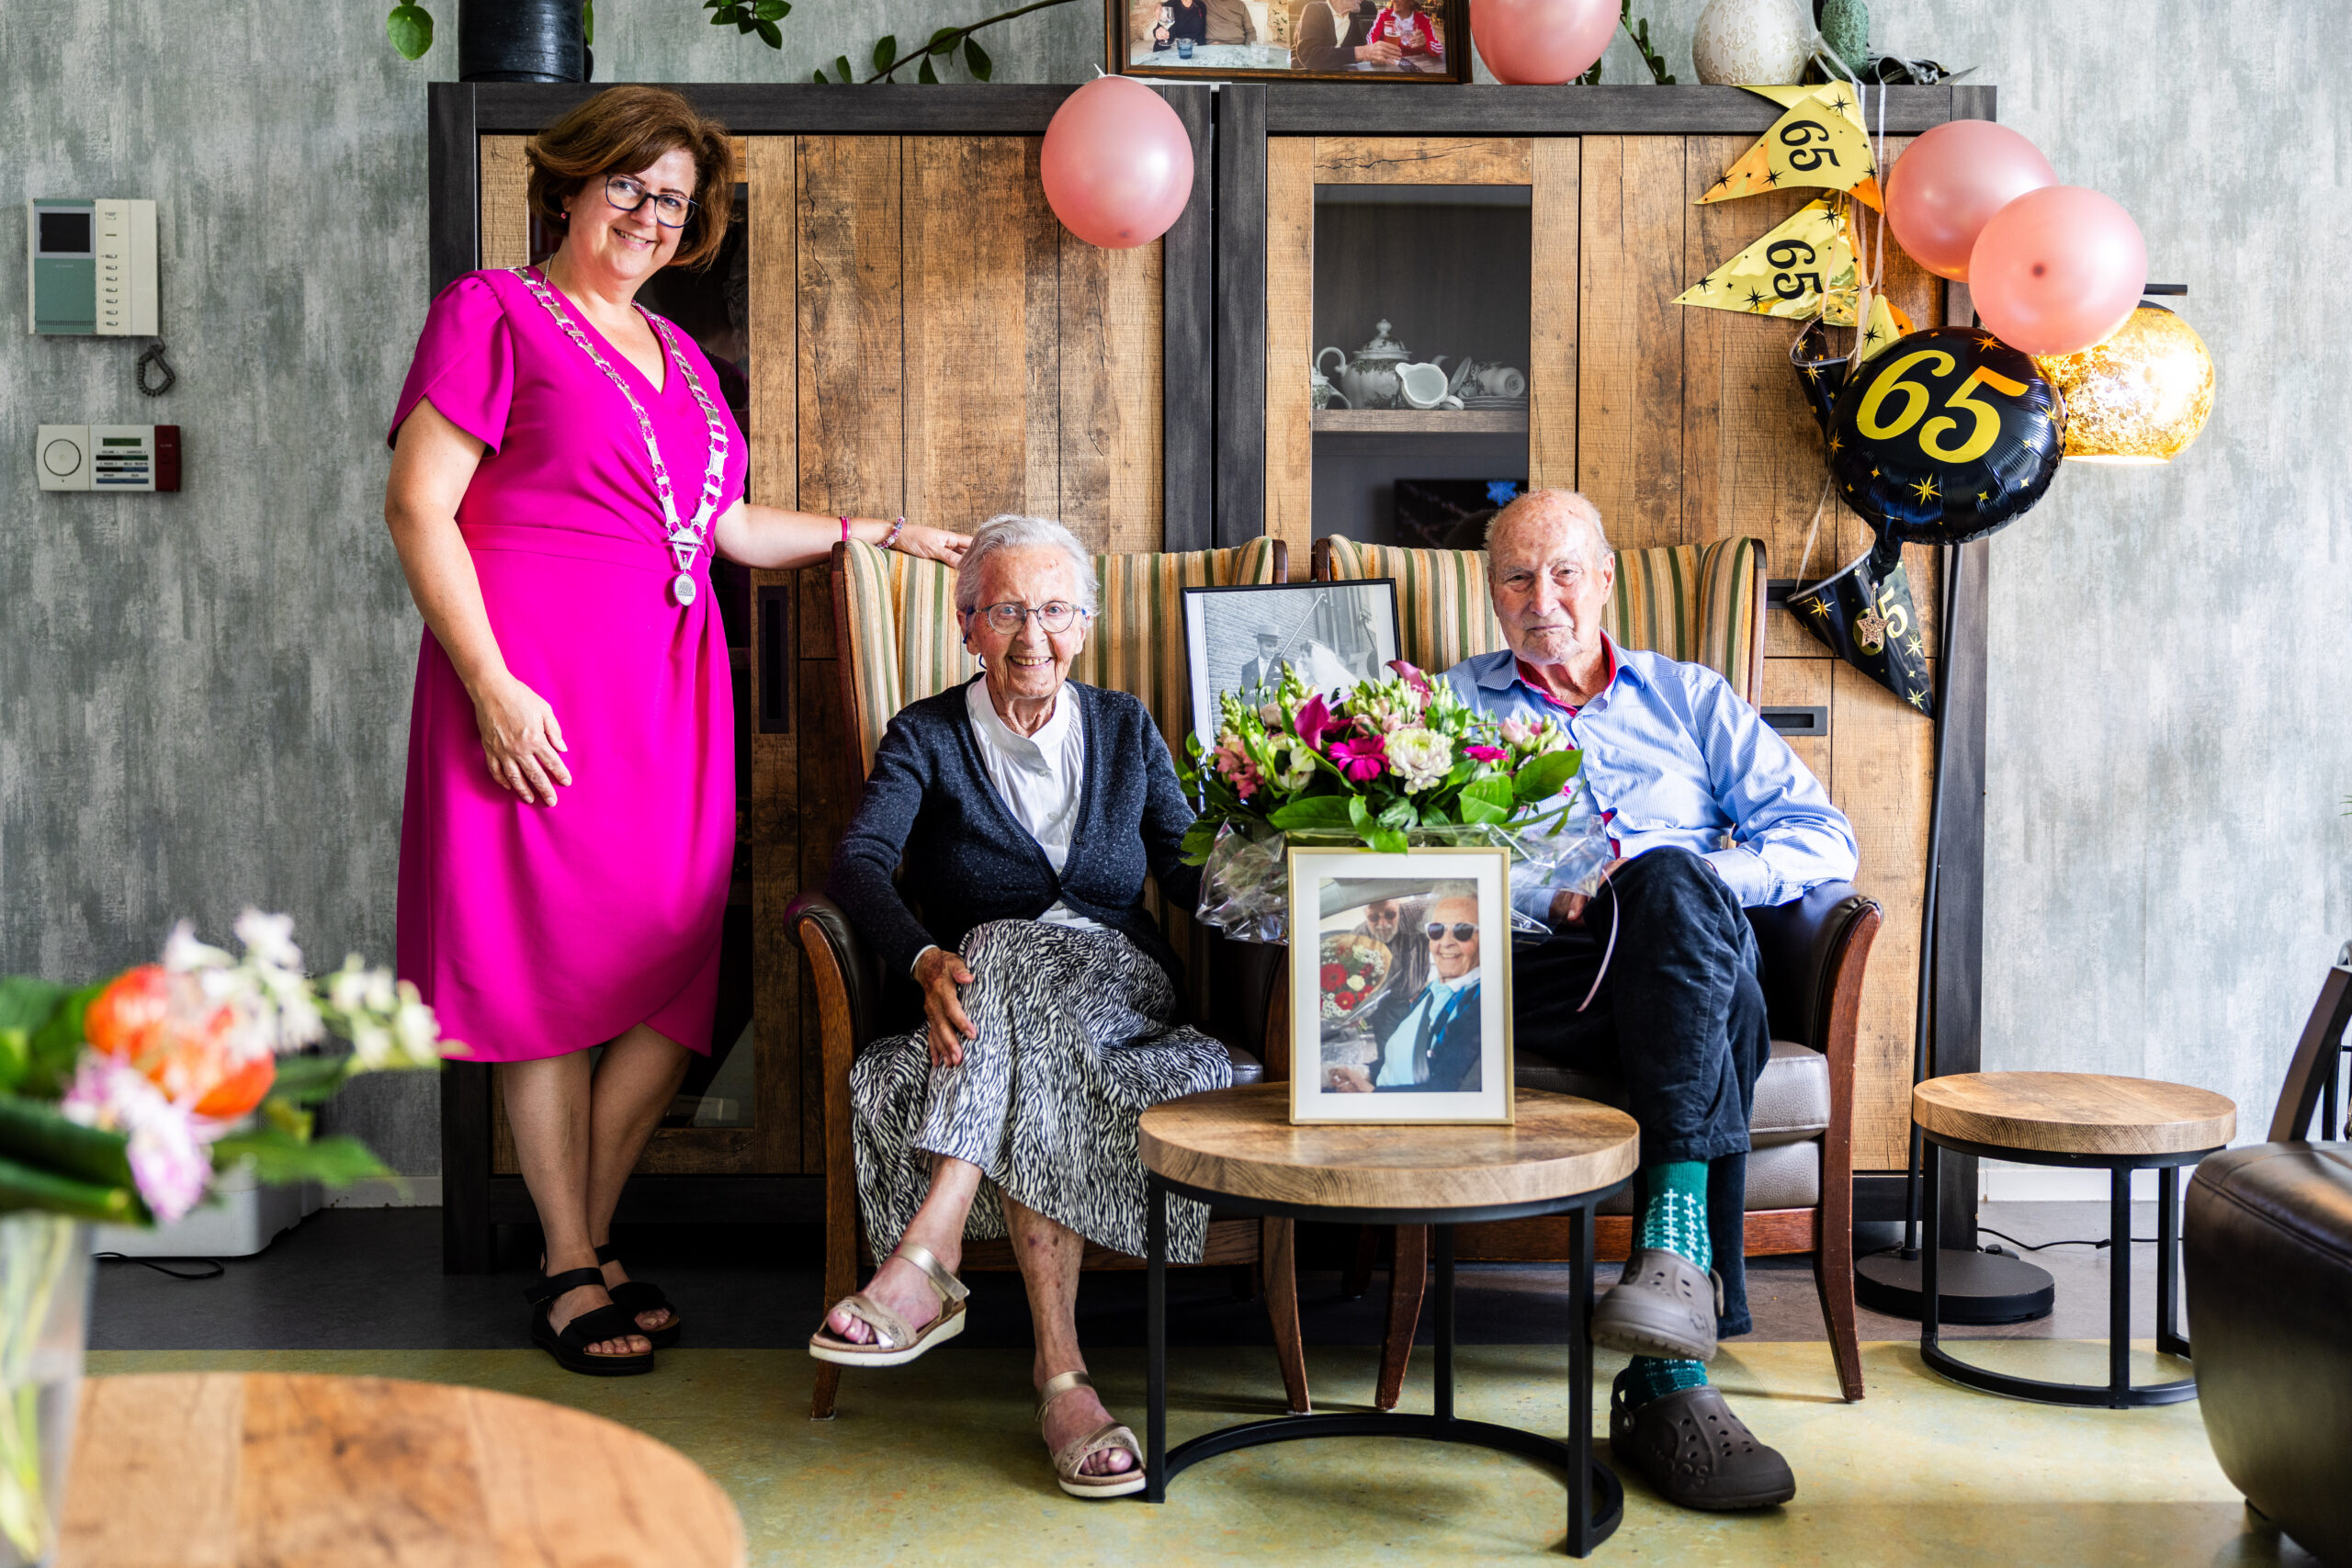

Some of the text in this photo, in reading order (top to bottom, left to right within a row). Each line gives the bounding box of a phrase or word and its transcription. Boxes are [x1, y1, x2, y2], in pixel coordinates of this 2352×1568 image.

[1780, 119, 1840, 171] 65
[1767, 240, 1823, 299] 65
[1857, 350, 2029, 463] 65
